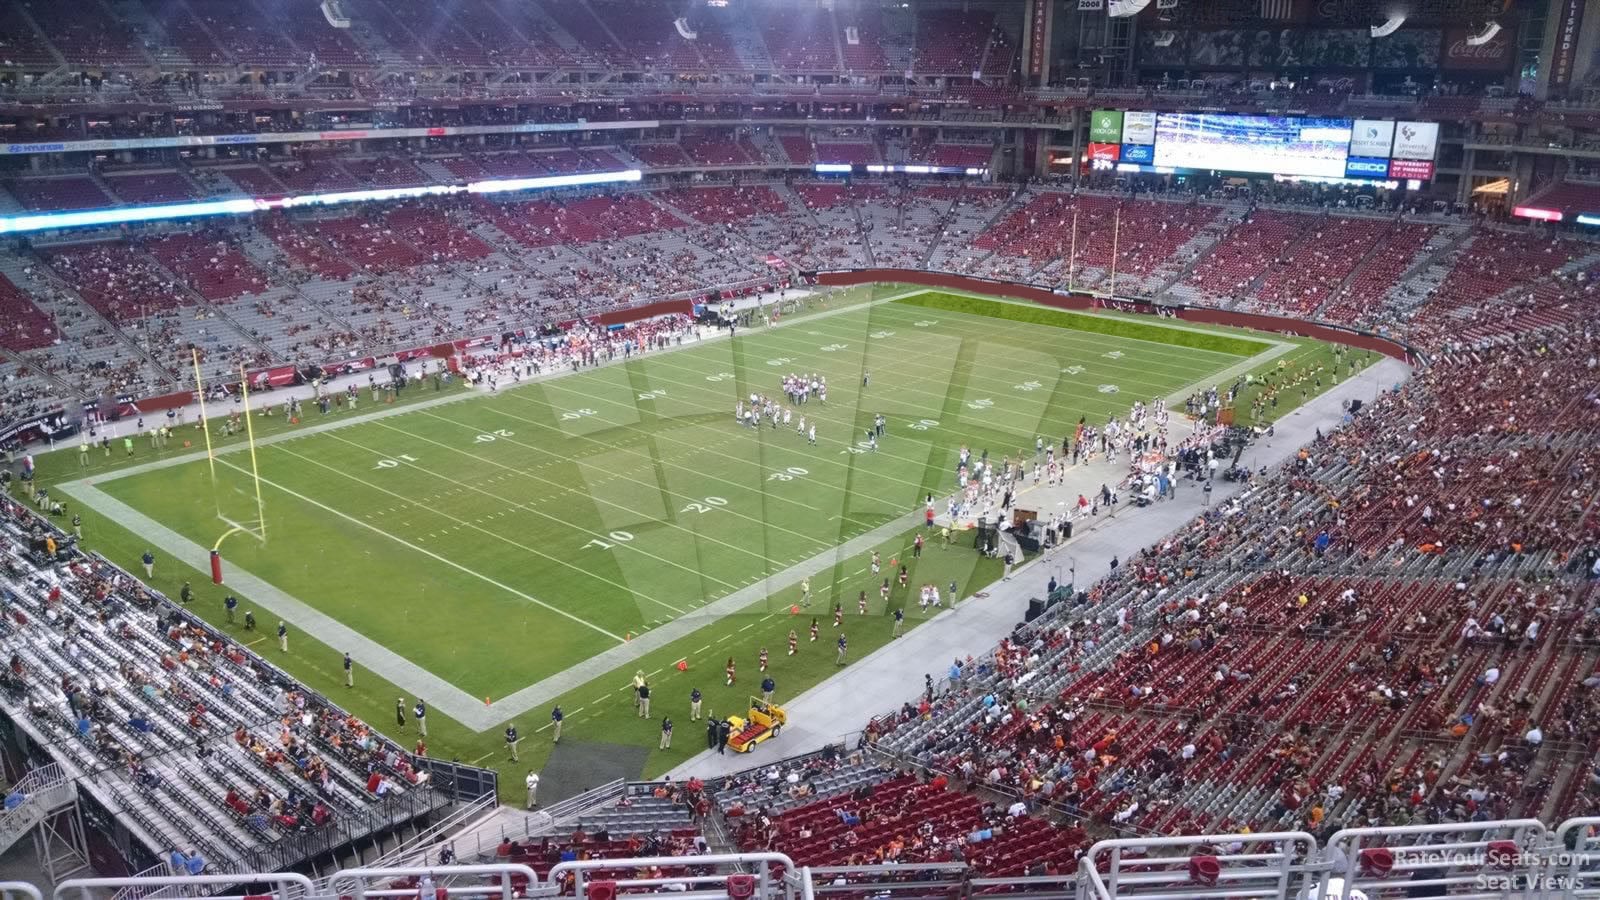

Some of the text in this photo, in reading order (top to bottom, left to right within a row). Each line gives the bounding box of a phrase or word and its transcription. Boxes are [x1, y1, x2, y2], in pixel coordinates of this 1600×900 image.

[1347, 163, 1387, 172] GEICO
[911, 419, 940, 431] 50
[476, 428, 515, 442] 20
[377, 453, 420, 468] 10
[770, 467, 809, 482] 30
[686, 496, 729, 514] 20
[590, 530, 635, 551] 10
